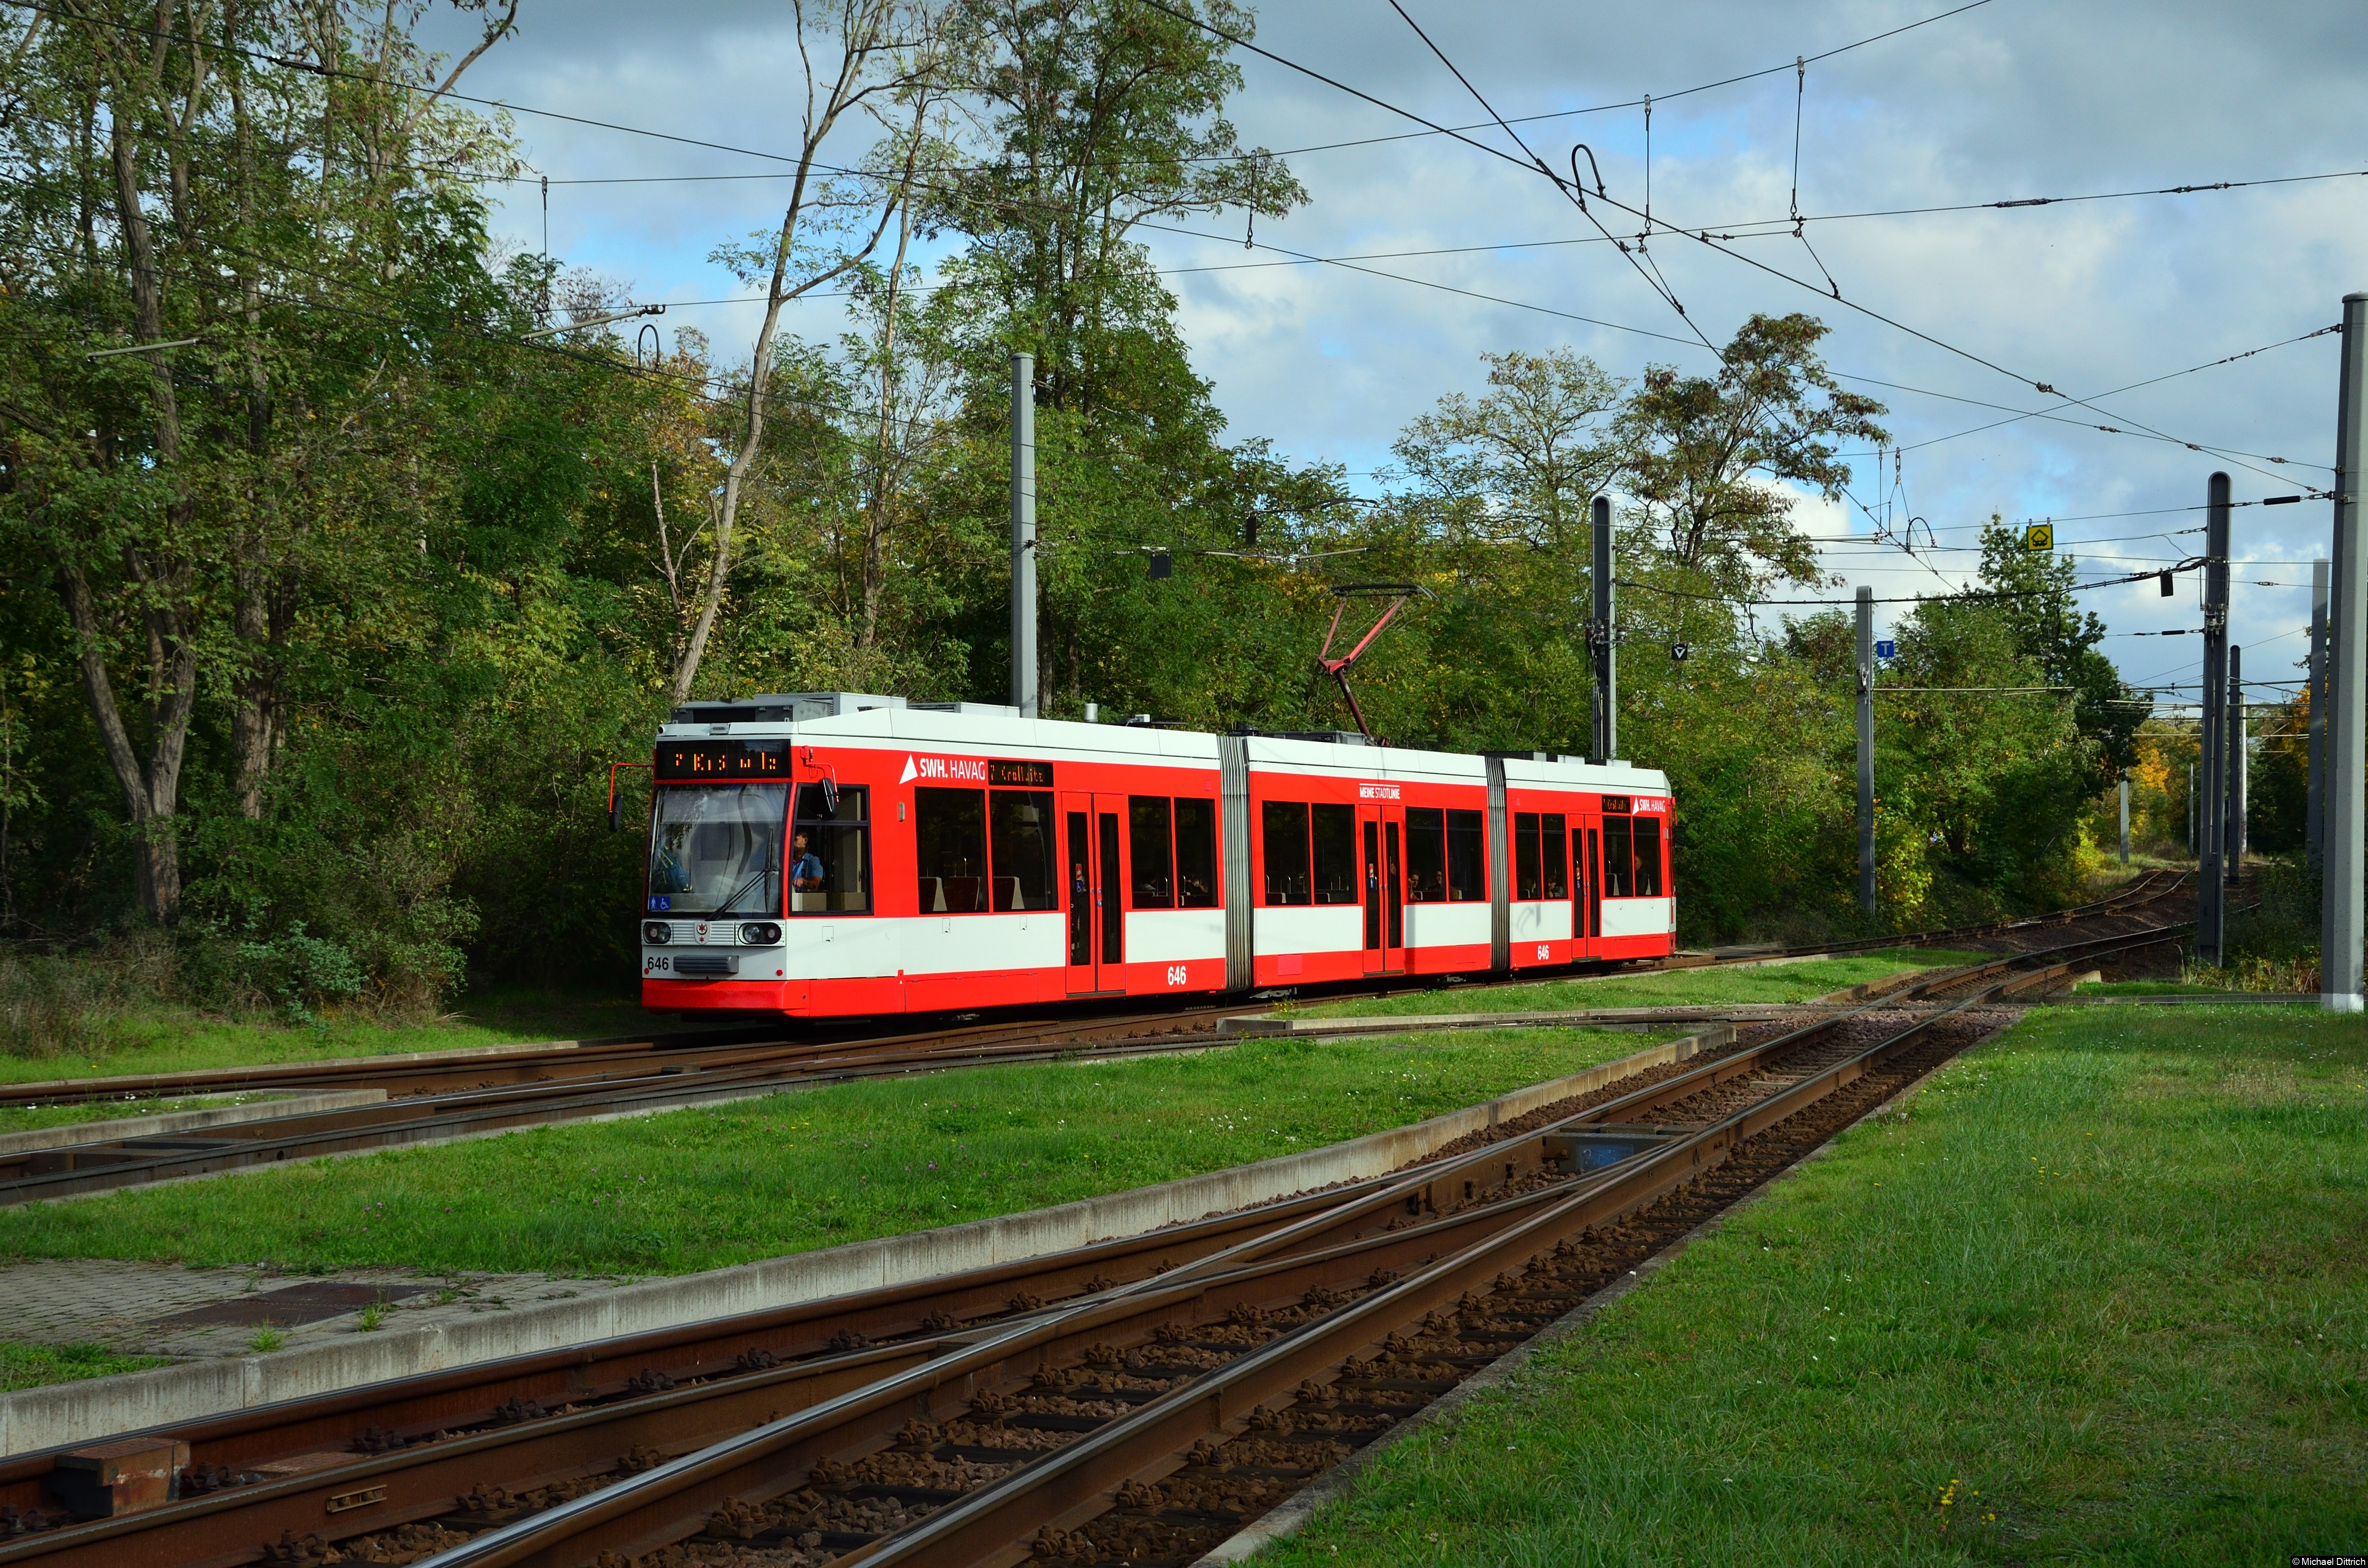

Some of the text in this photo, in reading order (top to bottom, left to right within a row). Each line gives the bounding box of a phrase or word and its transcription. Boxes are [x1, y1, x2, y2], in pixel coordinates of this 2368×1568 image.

[1881, 643, 1890, 655] T
[920, 758, 985, 780] SWH. HAVAG
[1360, 787, 1400, 800] MEINE STADTLINIE
[1639, 799, 1651, 811] SWH.
[1651, 800, 1666, 813] HAVAG
[1538, 944, 1549, 960] 646
[648, 956, 669, 970] 646
[1168, 965, 1186, 986] 646
